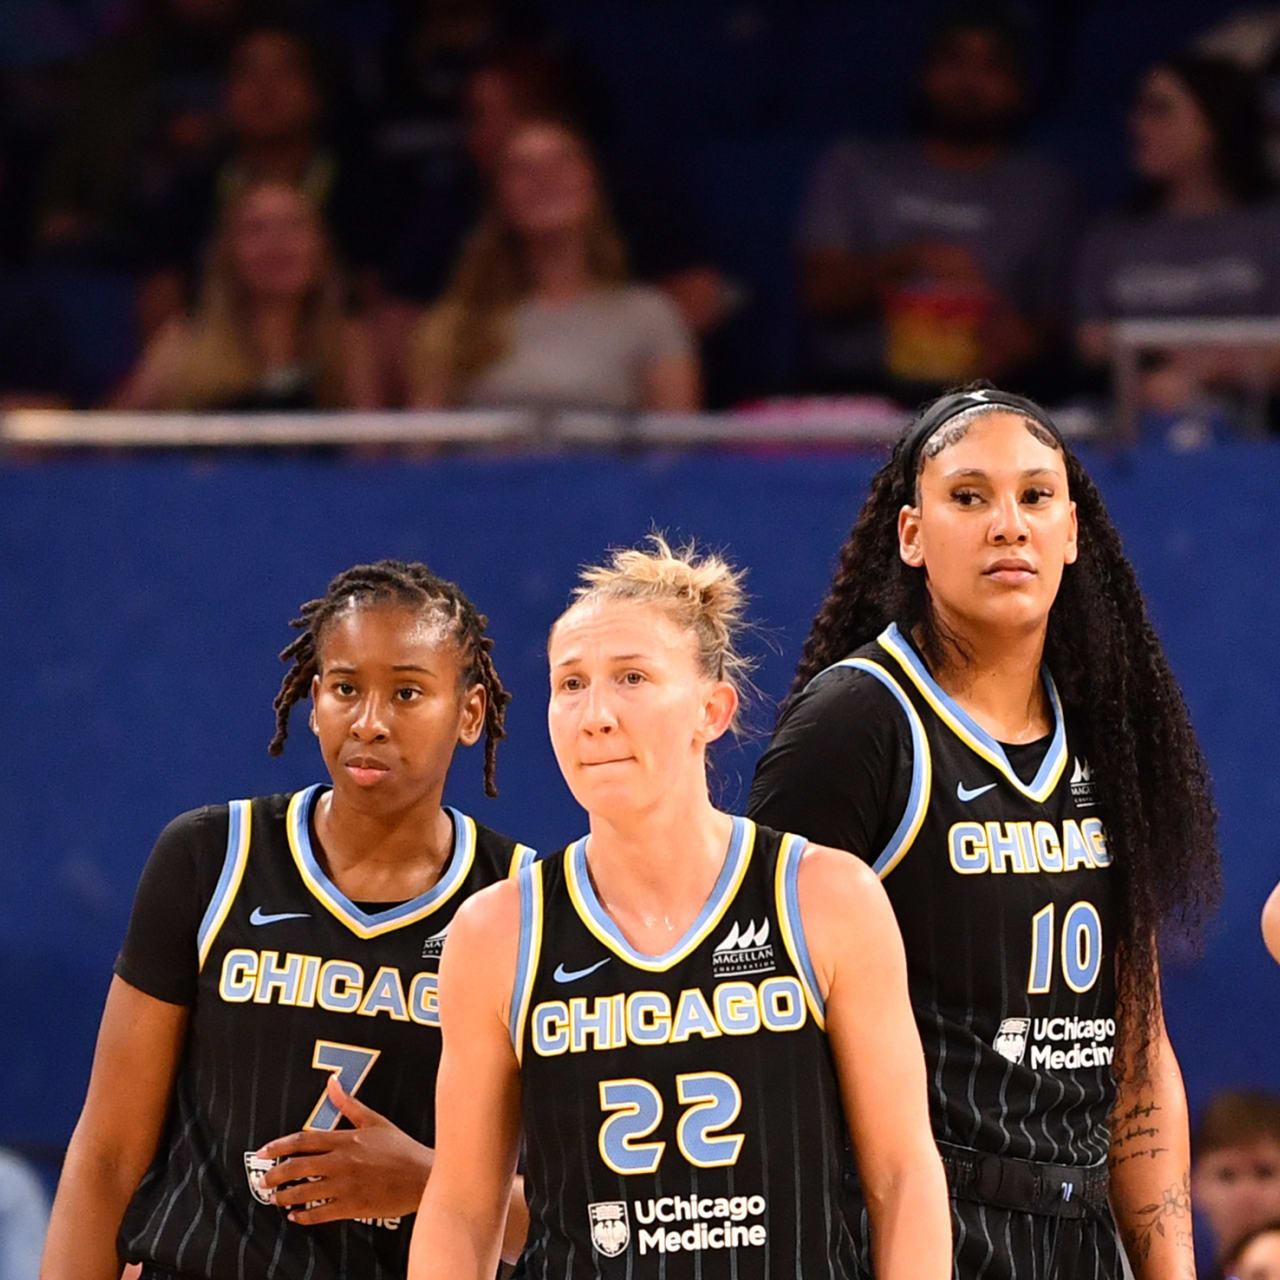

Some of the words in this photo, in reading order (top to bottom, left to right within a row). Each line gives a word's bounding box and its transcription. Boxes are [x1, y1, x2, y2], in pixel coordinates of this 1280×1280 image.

[947, 817, 1113, 874] CHICAG
[712, 947, 774, 965] MAGELLAN
[1026, 900, 1103, 994] 10
[219, 948, 441, 1027] CHICAG
[532, 976, 807, 1057] CHICAGO
[1033, 1016, 1116, 1041] UChicago
[1031, 1041, 1114, 1070] Medicin
[302, 1039, 381, 1131] 7
[598, 1071, 745, 1175] 22
[634, 1194, 765, 1224] UChicago
[638, 1222, 766, 1255] Medicine
